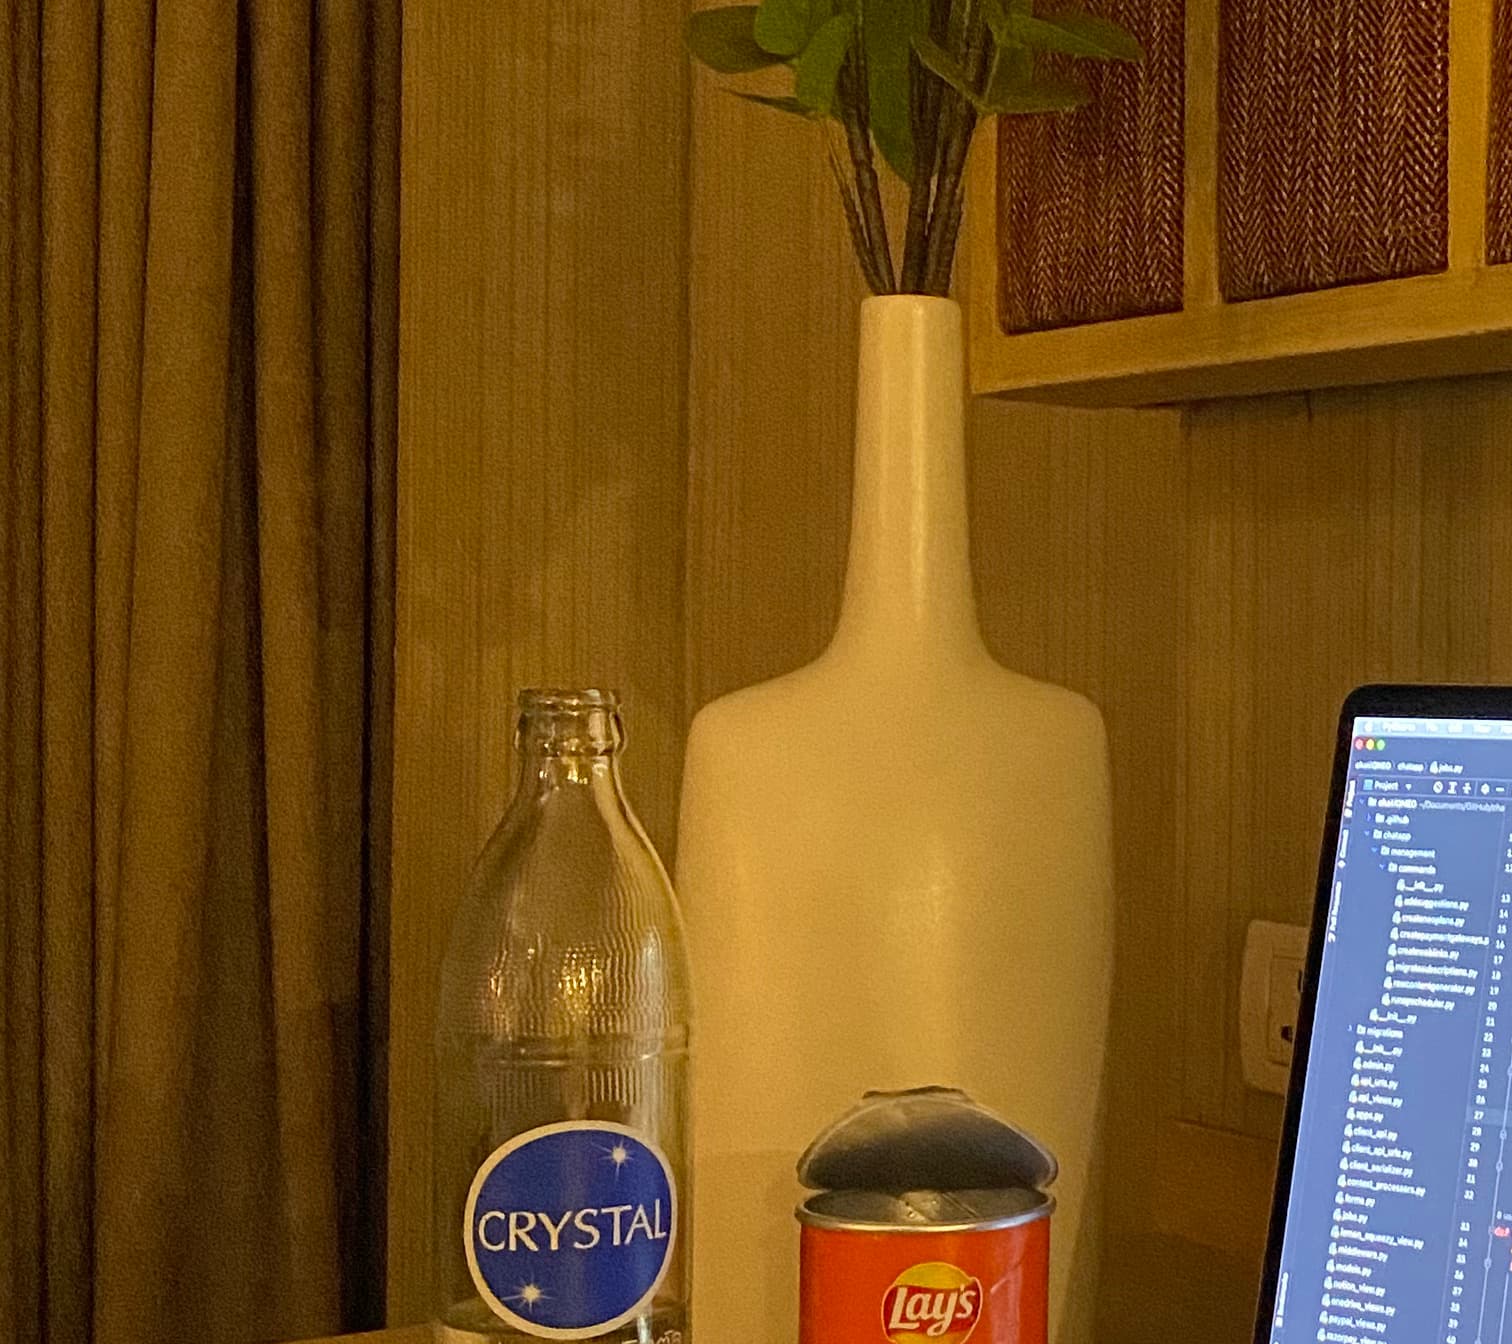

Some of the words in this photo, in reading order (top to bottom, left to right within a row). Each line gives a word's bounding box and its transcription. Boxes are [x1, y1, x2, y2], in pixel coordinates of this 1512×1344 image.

[1373, 779, 1399, 792] Project
[478, 1198, 667, 1252] CRYSTAL
[888, 1283, 977, 1337] Lay's
